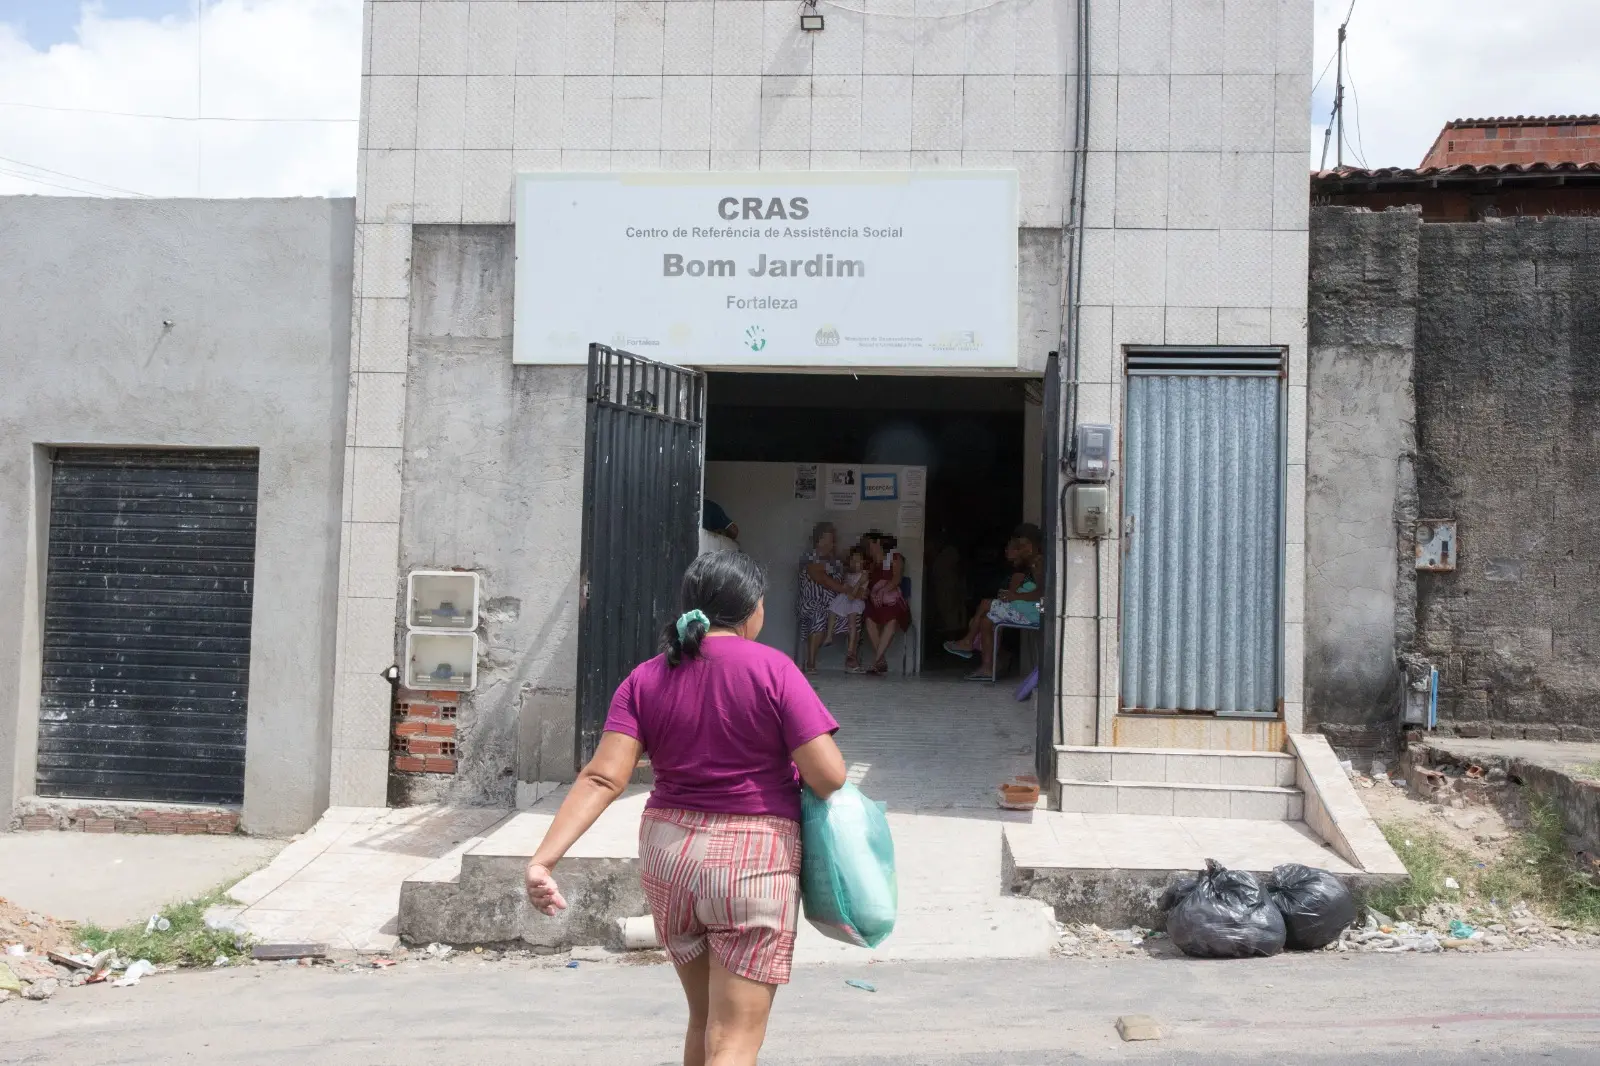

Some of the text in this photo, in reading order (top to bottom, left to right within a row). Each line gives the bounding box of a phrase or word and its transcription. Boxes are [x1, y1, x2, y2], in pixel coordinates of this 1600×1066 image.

[718, 197, 810, 220] CRAS
[625, 226, 903, 238] Centro de Referência de Assistência Social
[662, 254, 865, 277] Bom Jardim
[726, 295, 798, 309] Fortaleza
